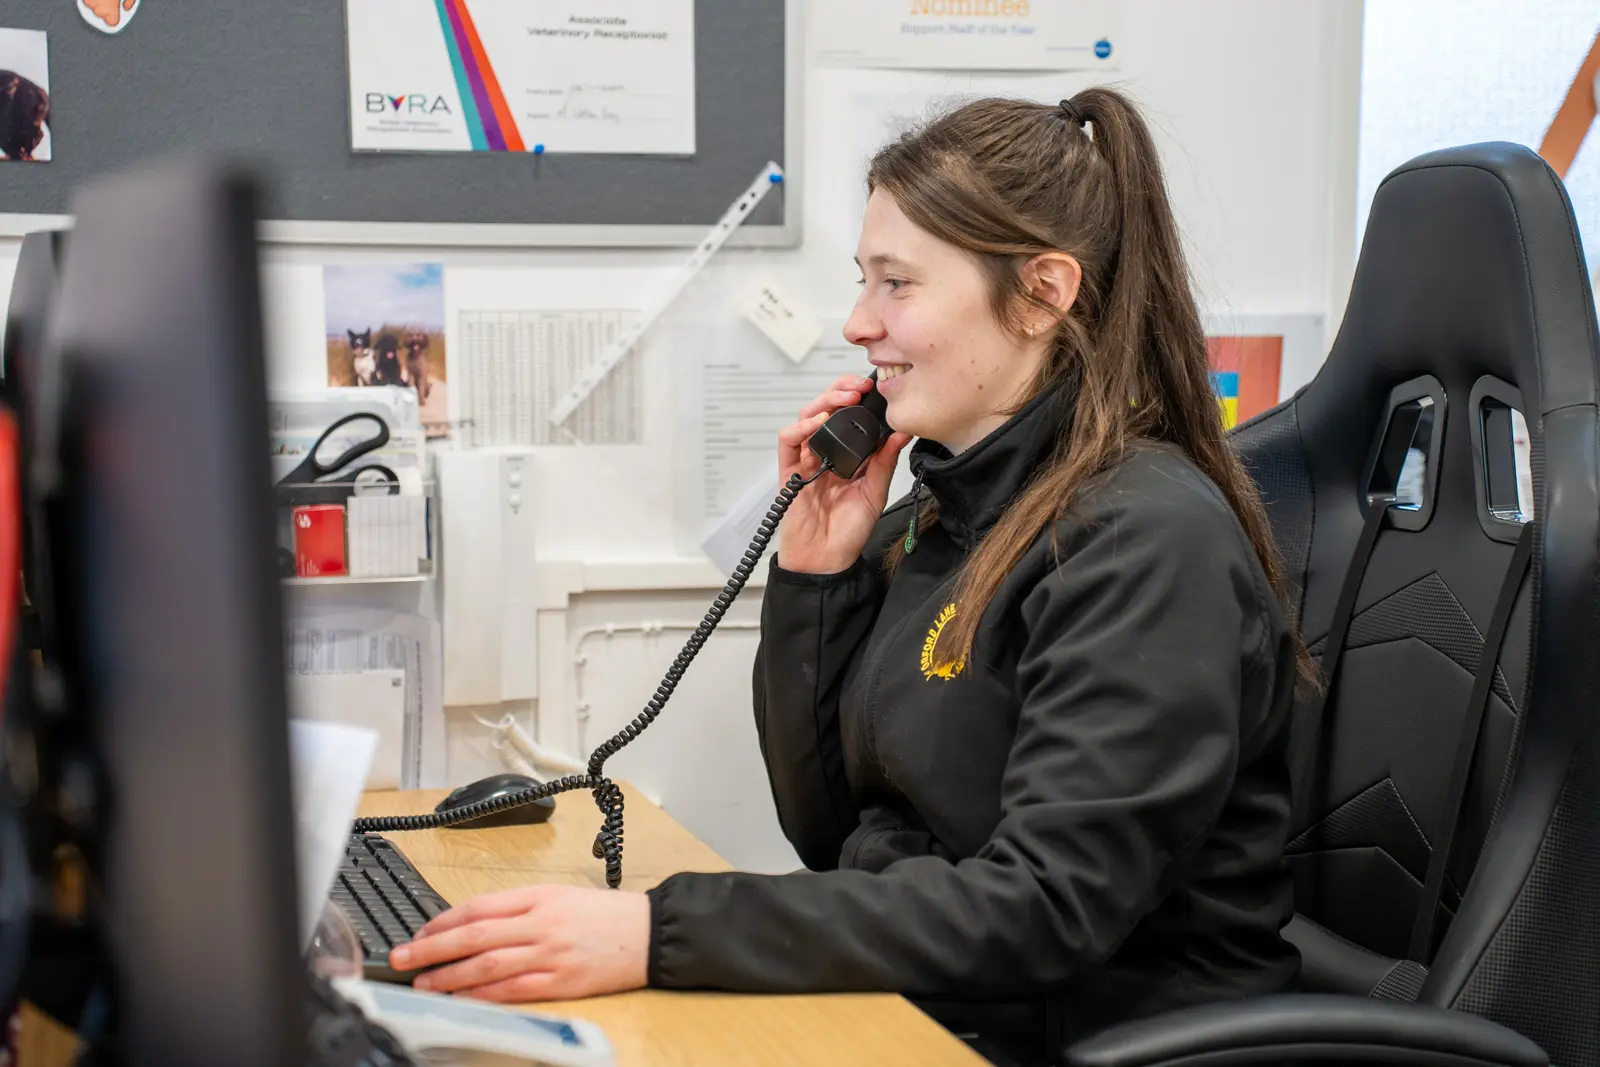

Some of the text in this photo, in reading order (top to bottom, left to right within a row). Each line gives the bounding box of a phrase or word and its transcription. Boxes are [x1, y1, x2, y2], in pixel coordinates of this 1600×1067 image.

[911, 0, 1031, 17] Nominee
[568, 15, 628, 25] Associate
[527, 27, 668, 40] Veterinary Receptionist
[901, 22, 945, 35] Support
[366, 92, 452, 115] BVRA
[920, 603, 956, 671] ORFORD LANE
